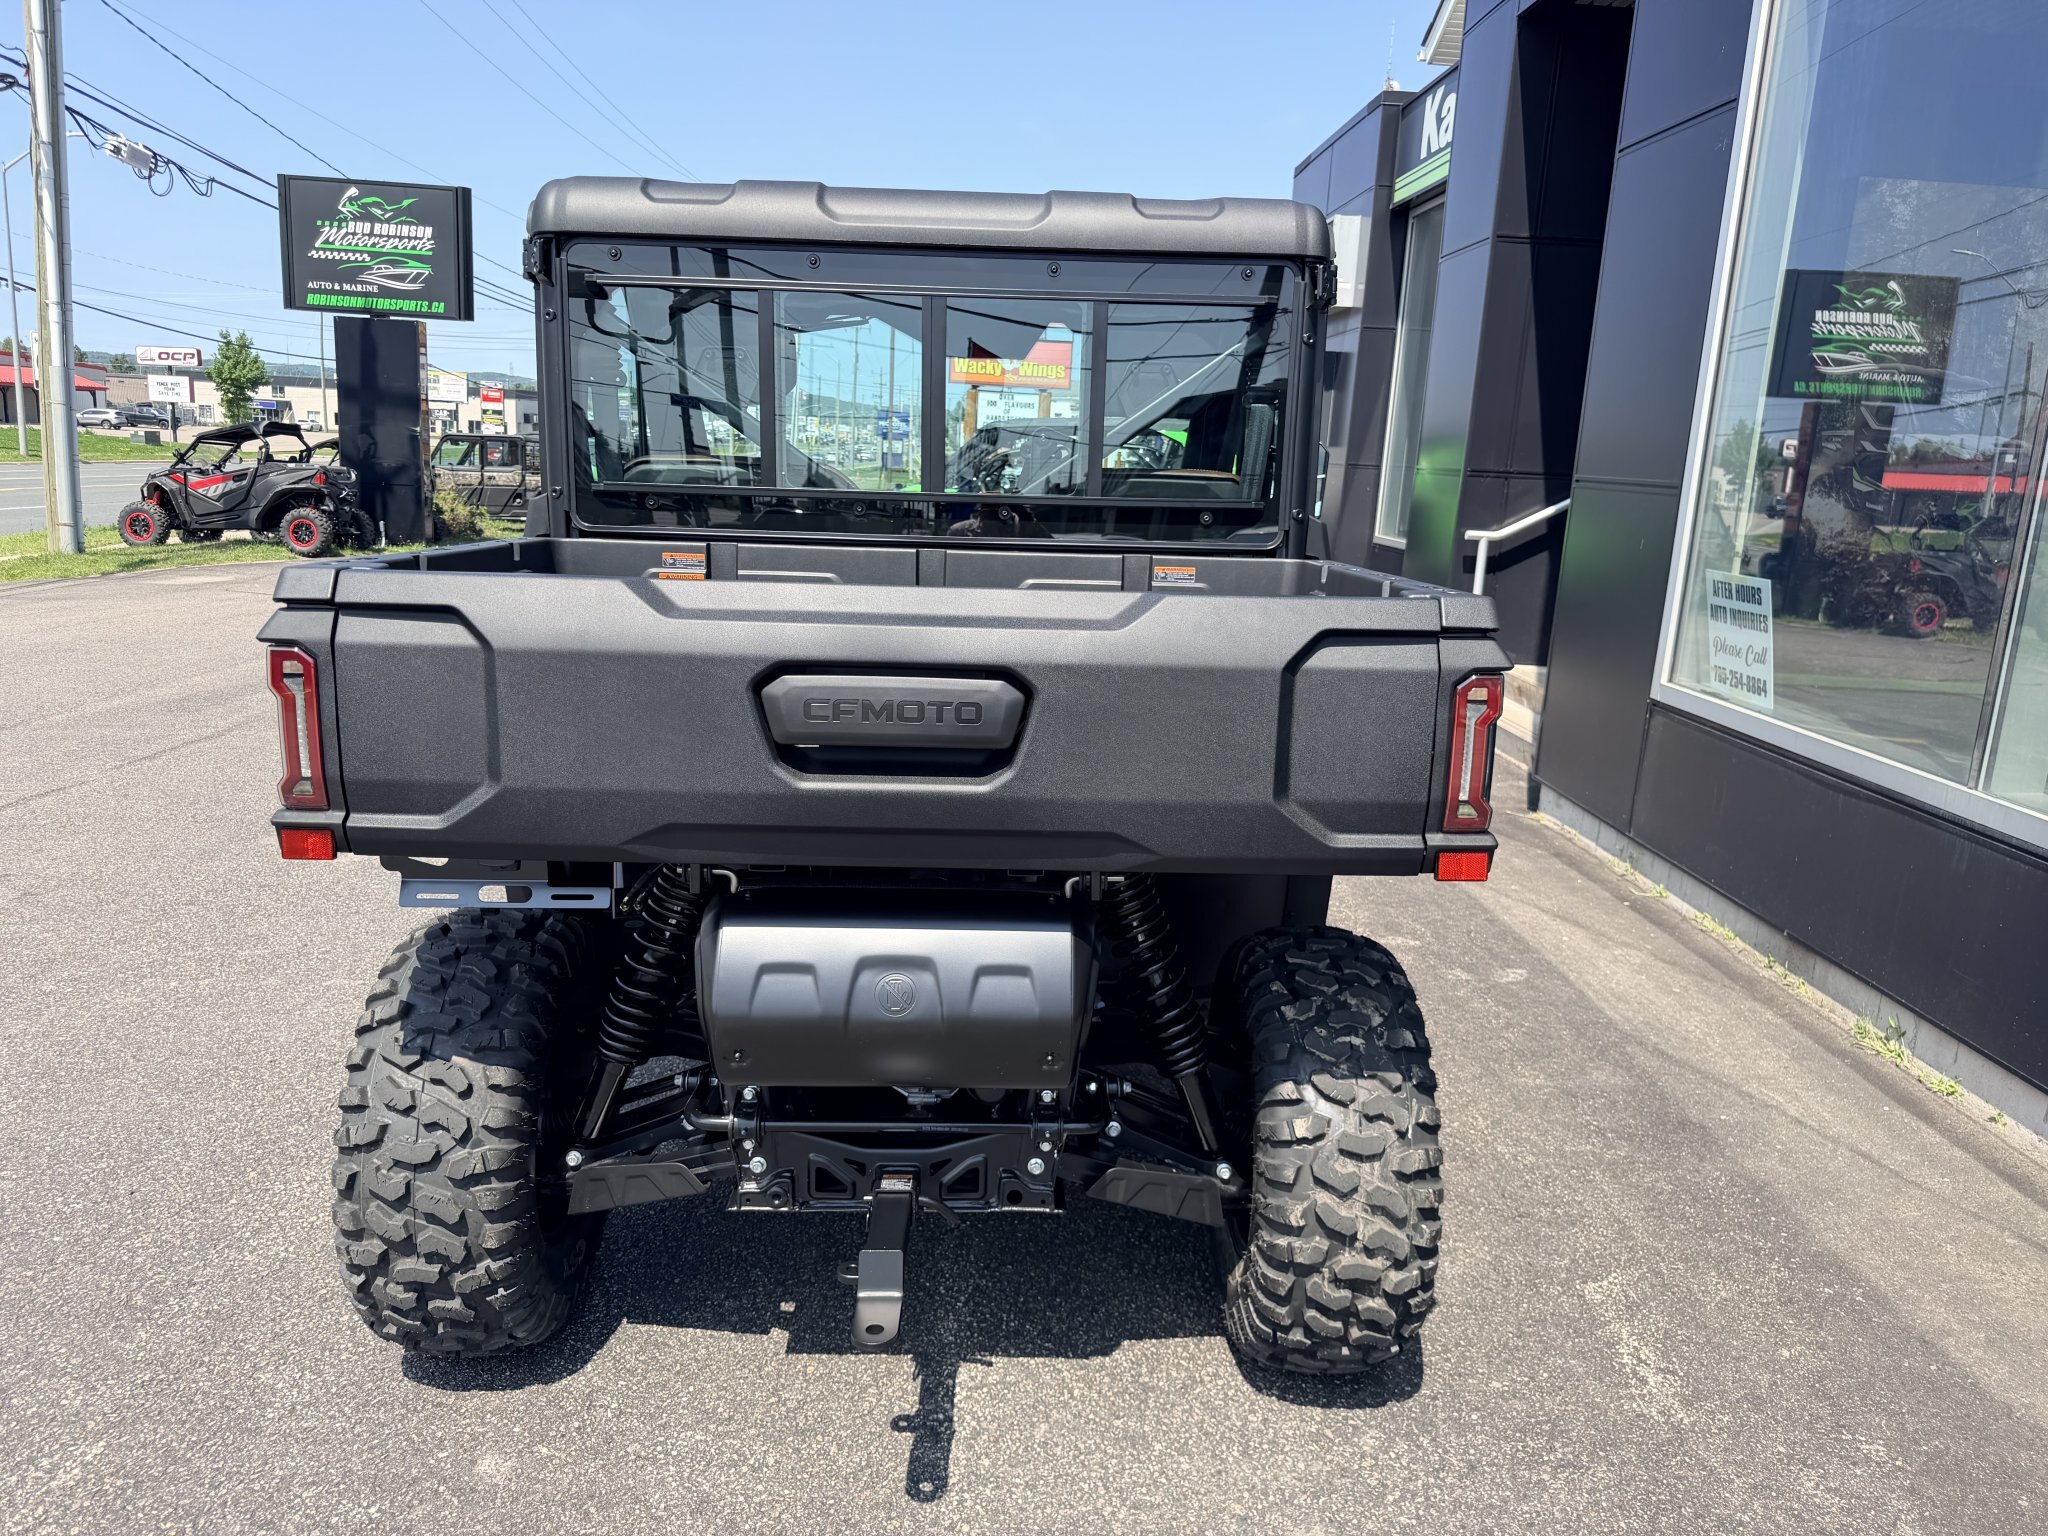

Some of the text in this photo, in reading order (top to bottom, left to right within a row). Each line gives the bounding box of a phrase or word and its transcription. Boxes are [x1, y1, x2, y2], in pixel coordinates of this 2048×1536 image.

[315, 226, 436, 251] Motorsports
[348, 221, 433, 239] BUD ROBINSON
[307, 280, 379, 293] AUTO & MARINE
[306, 293, 445, 314] ROBINSONMOTORSPORTS.CA
[158, 351, 196, 361] OCP
[954, 357, 1066, 378] Wacky Wings
[1712, 579, 1762, 606] AFTER HOURS
[1710, 603, 1769, 634] AUTO INQUIRIES
[1712, 635, 1768, 668] Please Call
[803, 698, 983, 726] CFMOTO
